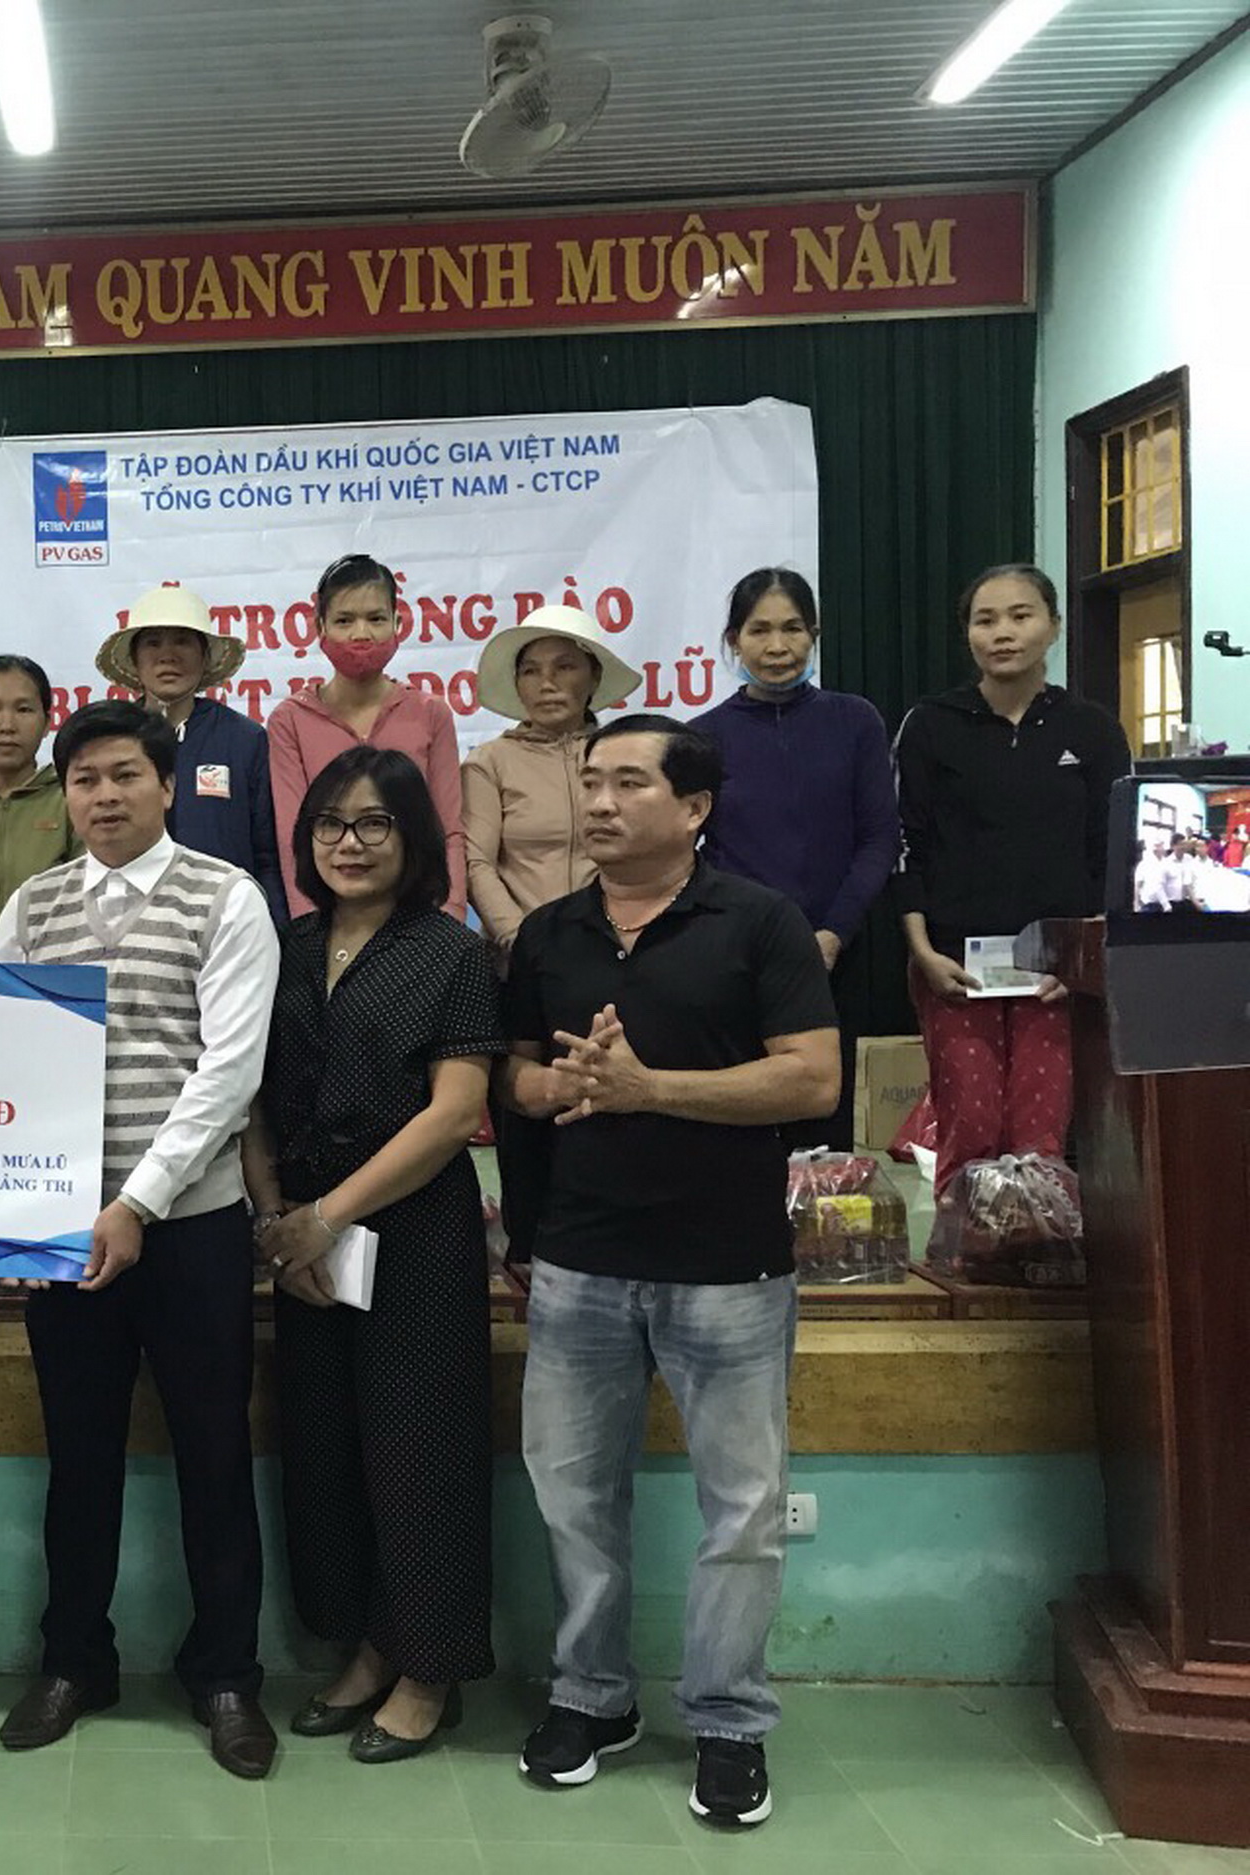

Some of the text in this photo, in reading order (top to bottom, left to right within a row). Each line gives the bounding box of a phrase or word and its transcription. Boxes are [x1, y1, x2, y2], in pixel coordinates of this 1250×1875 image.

[95, 249, 330, 340] QUANG
[349, 240, 534, 315] VINH
[556, 214, 768, 304] MUÔN
[792, 202, 957, 293] NĂM
[121, 434, 621, 483] TẬP ĐOÀN DẦU KHÍ QUỐC GIA VIỆT NAM
[140, 483, 211, 512] TỔNG
[219, 482, 292, 509] CÔNG
[300, 483, 331, 504] TY
[339, 475, 381, 503] KHÍ
[388, 474, 444, 504] VIỆT
[452, 474, 509, 498] NAM
[531, 469, 601, 493] CTCP
[642, 645, 716, 708] LŨ
[42, 1179, 73, 1195] TRỊ
